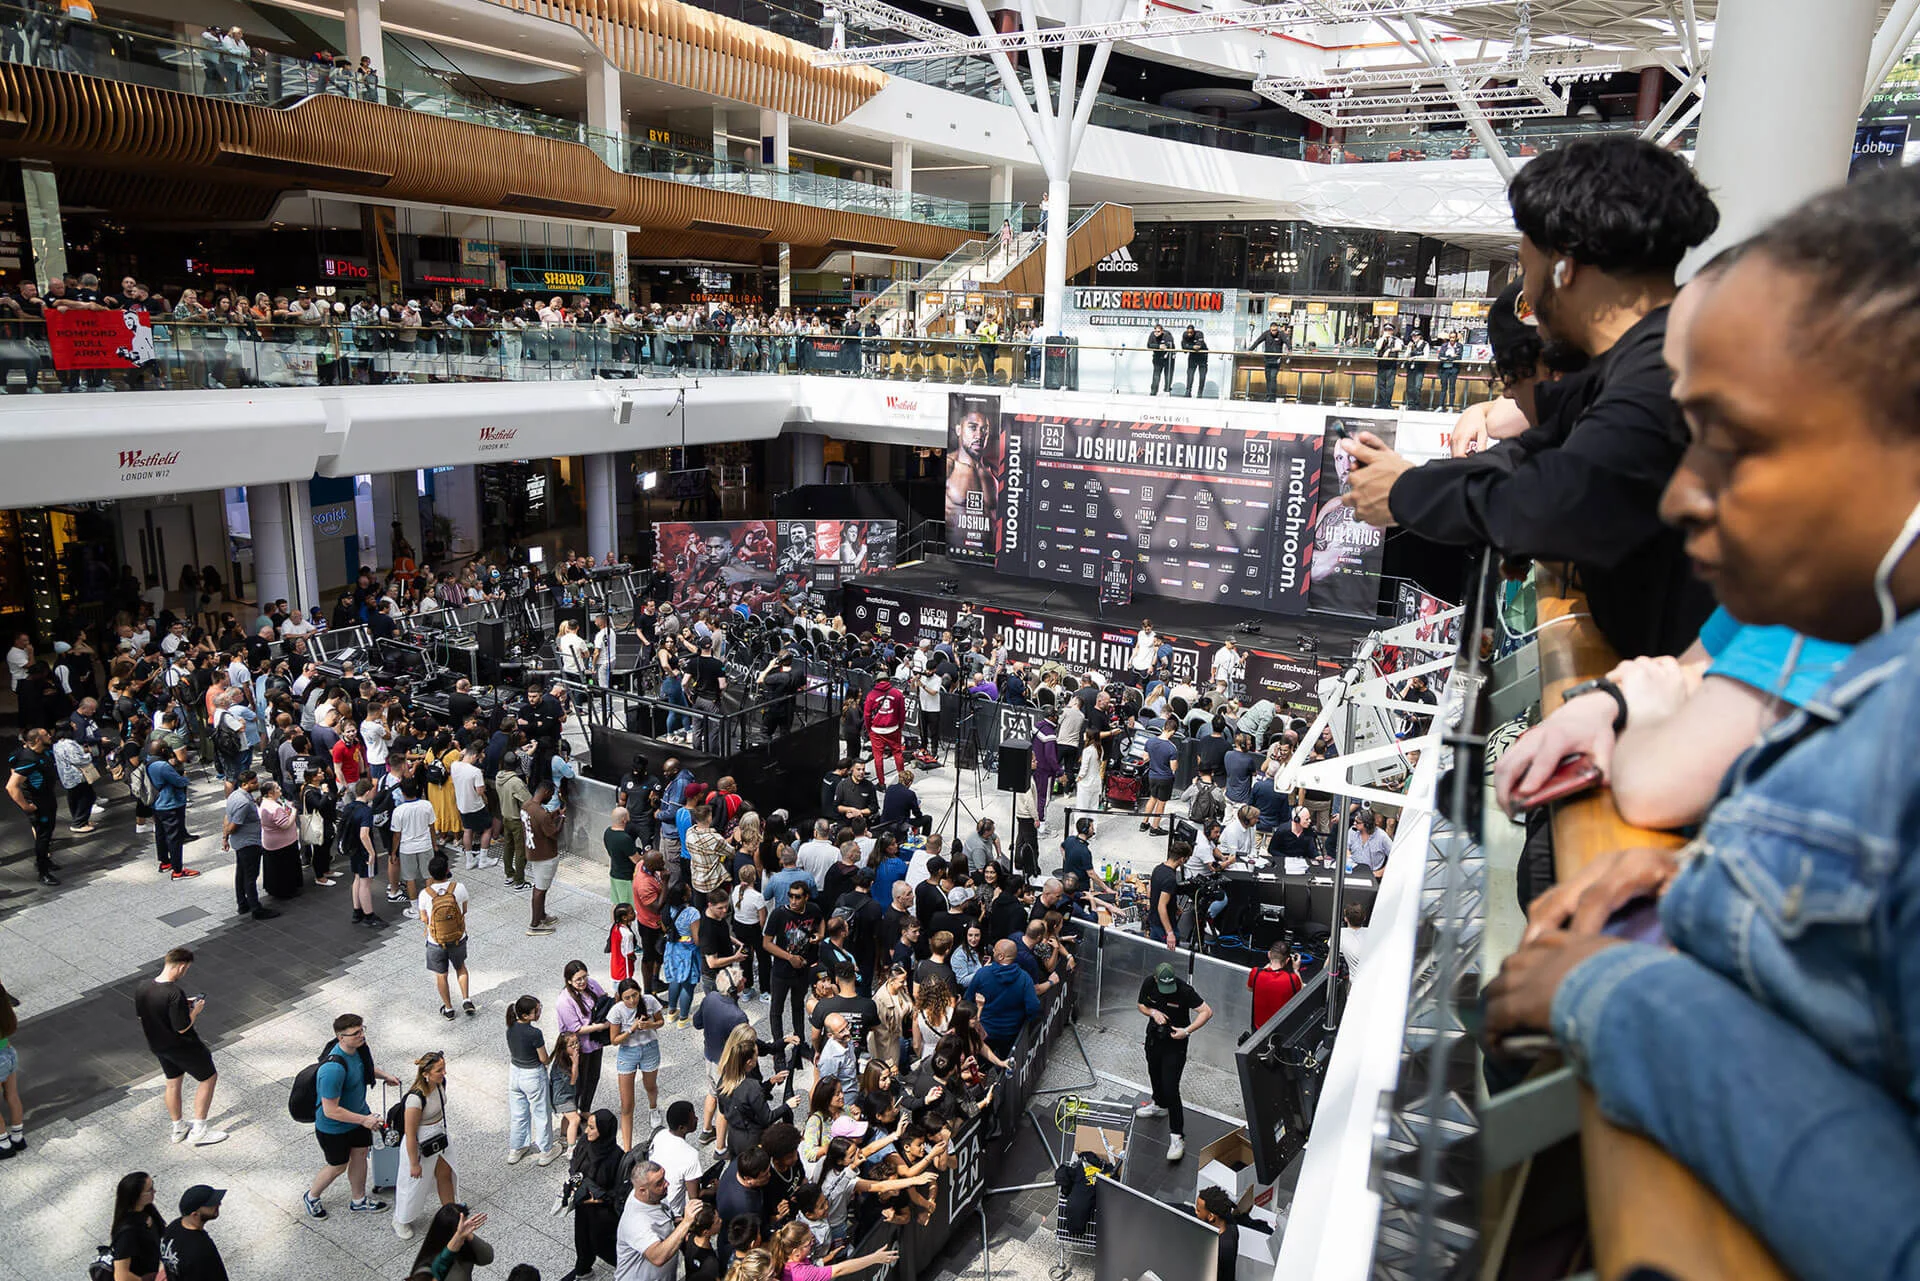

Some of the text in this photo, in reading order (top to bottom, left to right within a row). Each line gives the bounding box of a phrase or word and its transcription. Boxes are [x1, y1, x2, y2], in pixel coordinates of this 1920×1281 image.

[1855, 141, 1895, 156] Lobby
[337, 260, 368, 277] Pho
[1097, 260, 1139, 272] adidas
[886, 395, 918, 411] Westfield
[479, 427, 518, 441] Westfield
[117, 449, 181, 469] Westfield
[1075, 436, 1137, 463] JOSHUA
[1144, 441, 1228, 471] HELENIUS
[121, 471, 153, 482] LONDON
[958, 514, 990, 532] JOSHUA
[1325, 525, 1380, 547] HELENIUS
[920, 607, 948, 619] LIVE ON
[920, 614, 947, 629] DAZN
[1015, 618, 1043, 629] BETFRED
[918, 628, 937, 639] AUG
[1052, 625, 1093, 638] matchroom.
[1102, 632, 1133, 644] BETFRED
[1028, 656, 1043, 666] AUG
[1174, 652, 1192, 666] DA
[1172, 664, 1191, 677] ZN
[1260, 677, 1297, 690] Lucozade
[958, 1134, 980, 1173] DA
[958, 1158, 979, 1200] ZN
